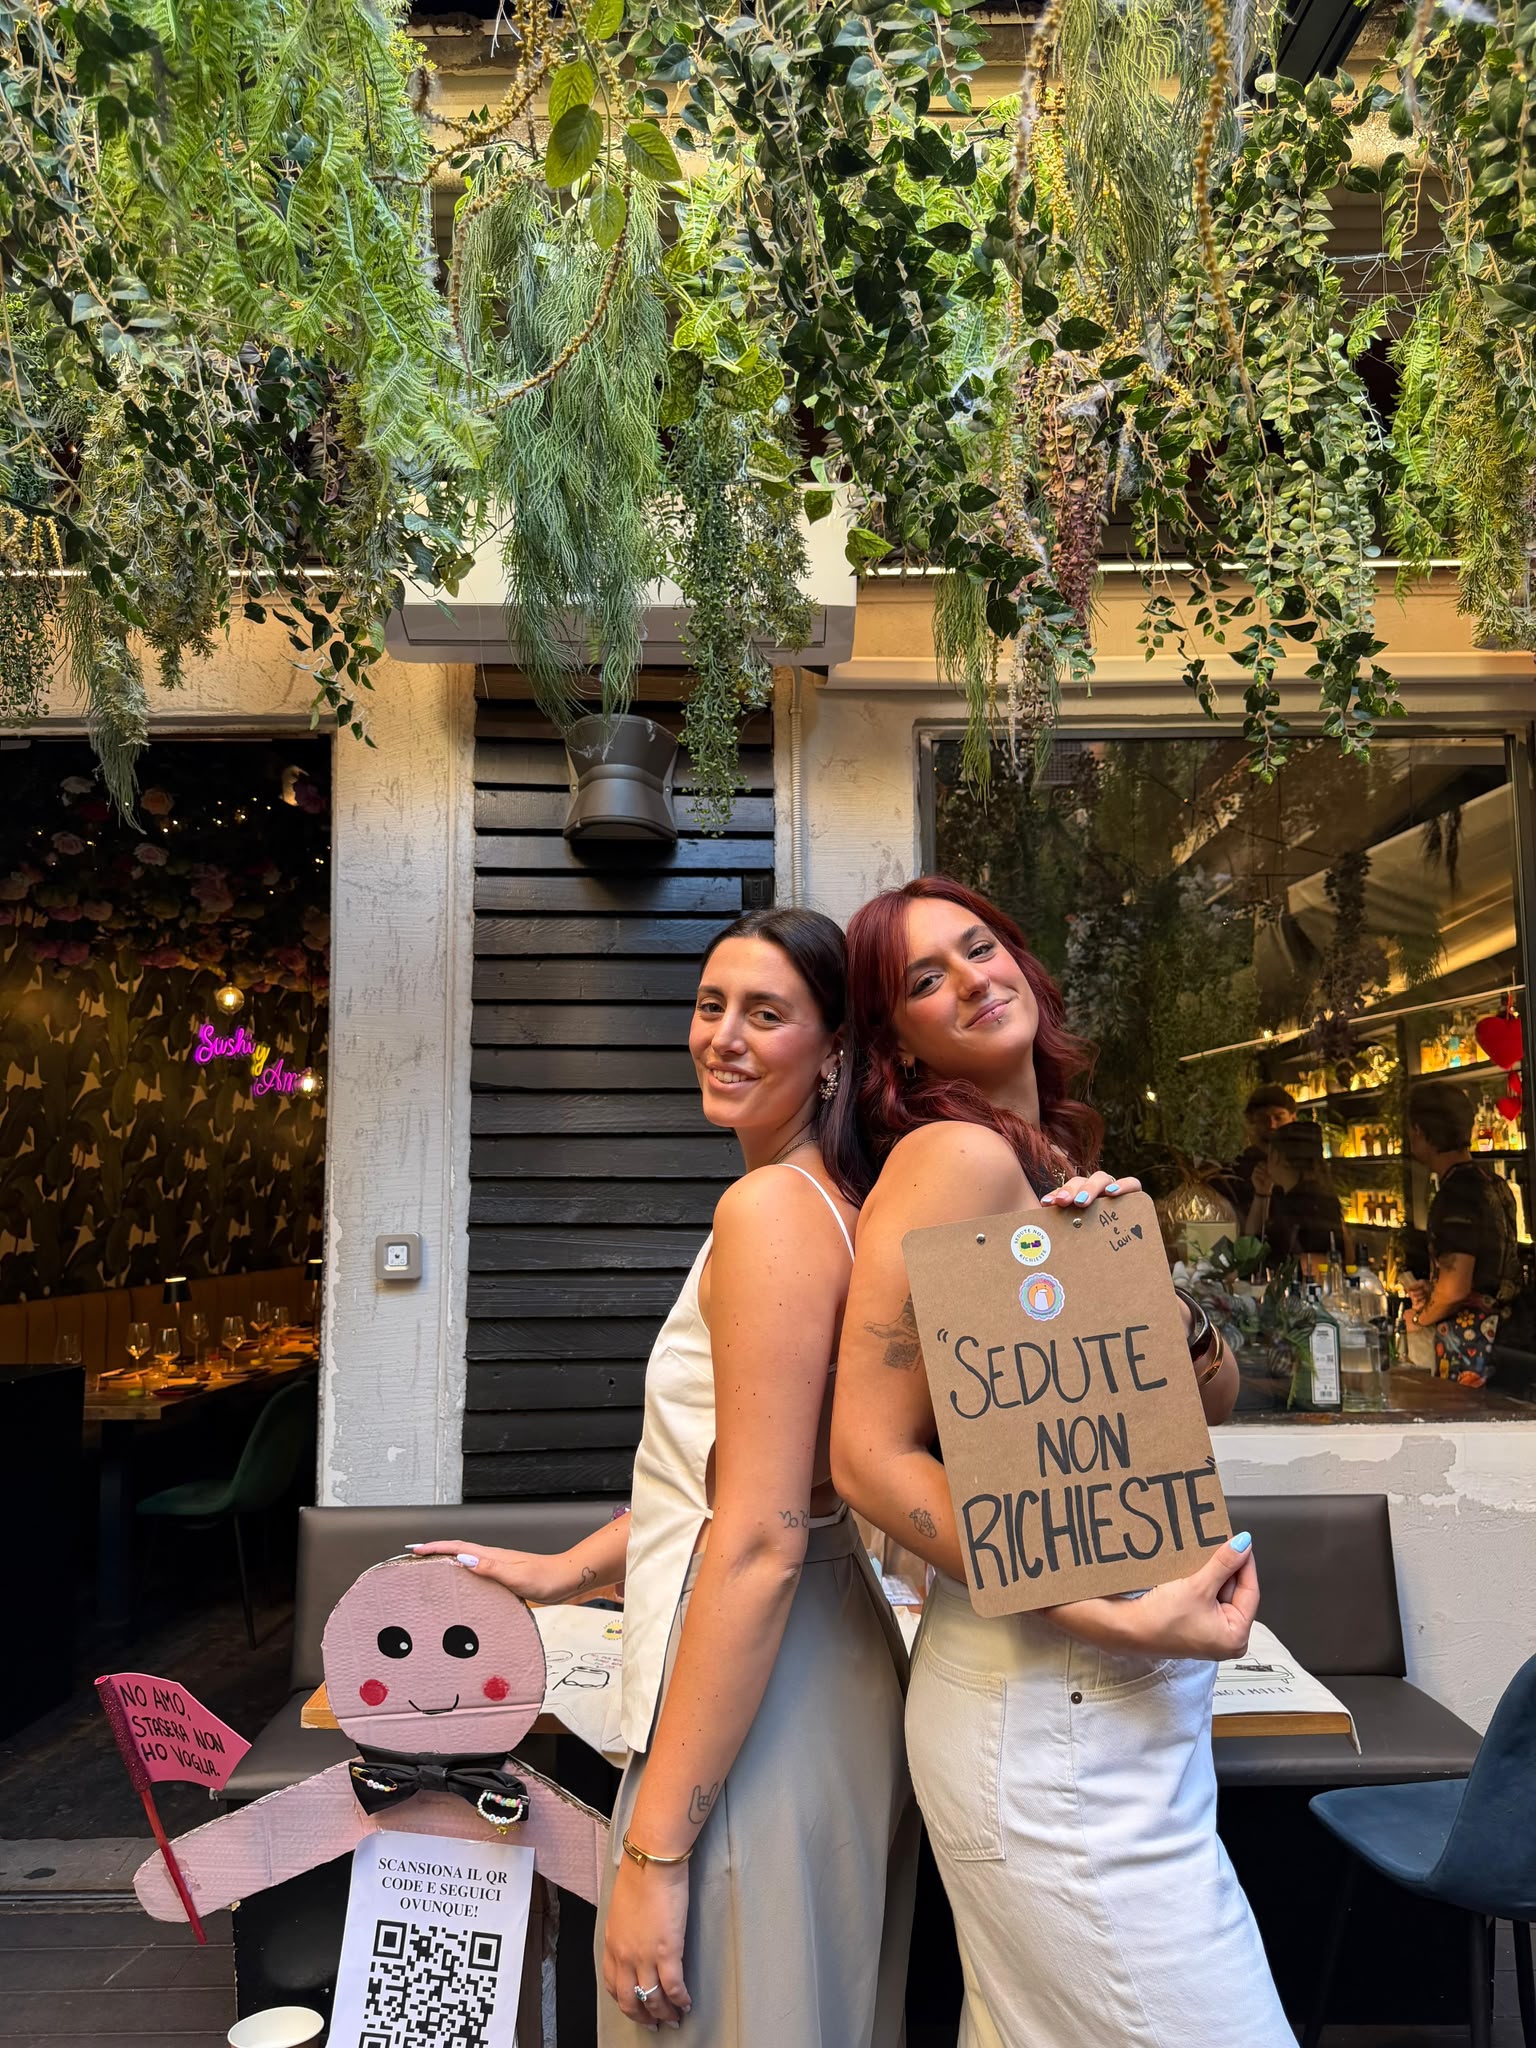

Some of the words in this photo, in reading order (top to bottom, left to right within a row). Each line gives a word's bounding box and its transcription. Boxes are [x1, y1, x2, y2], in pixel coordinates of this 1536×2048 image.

[194, 1023, 257, 1064] Sushi
[251, 1044, 271, 1077] y
[1098, 1210, 1119, 1227] Ale
[1108, 1229, 1132, 1252] Lavi
[1036, 1412, 1131, 1477] NON
[119, 1682, 147, 1707] NO
[131, 1715, 190, 1744] STASERA
[193, 1729, 226, 1754] NON
[140, 1743, 168, 1762] HO
[378, 1857, 463, 1880] SCANSIONA
[467, 1867, 483, 1882] IL
[485, 1869, 508, 1885] QR
[381, 1876, 423, 1894] CODE
[426, 1881, 437, 1895] E
[439, 1883, 502, 1902] SEGUICI
[399, 1896, 479, 1918] OVUNQUE!
